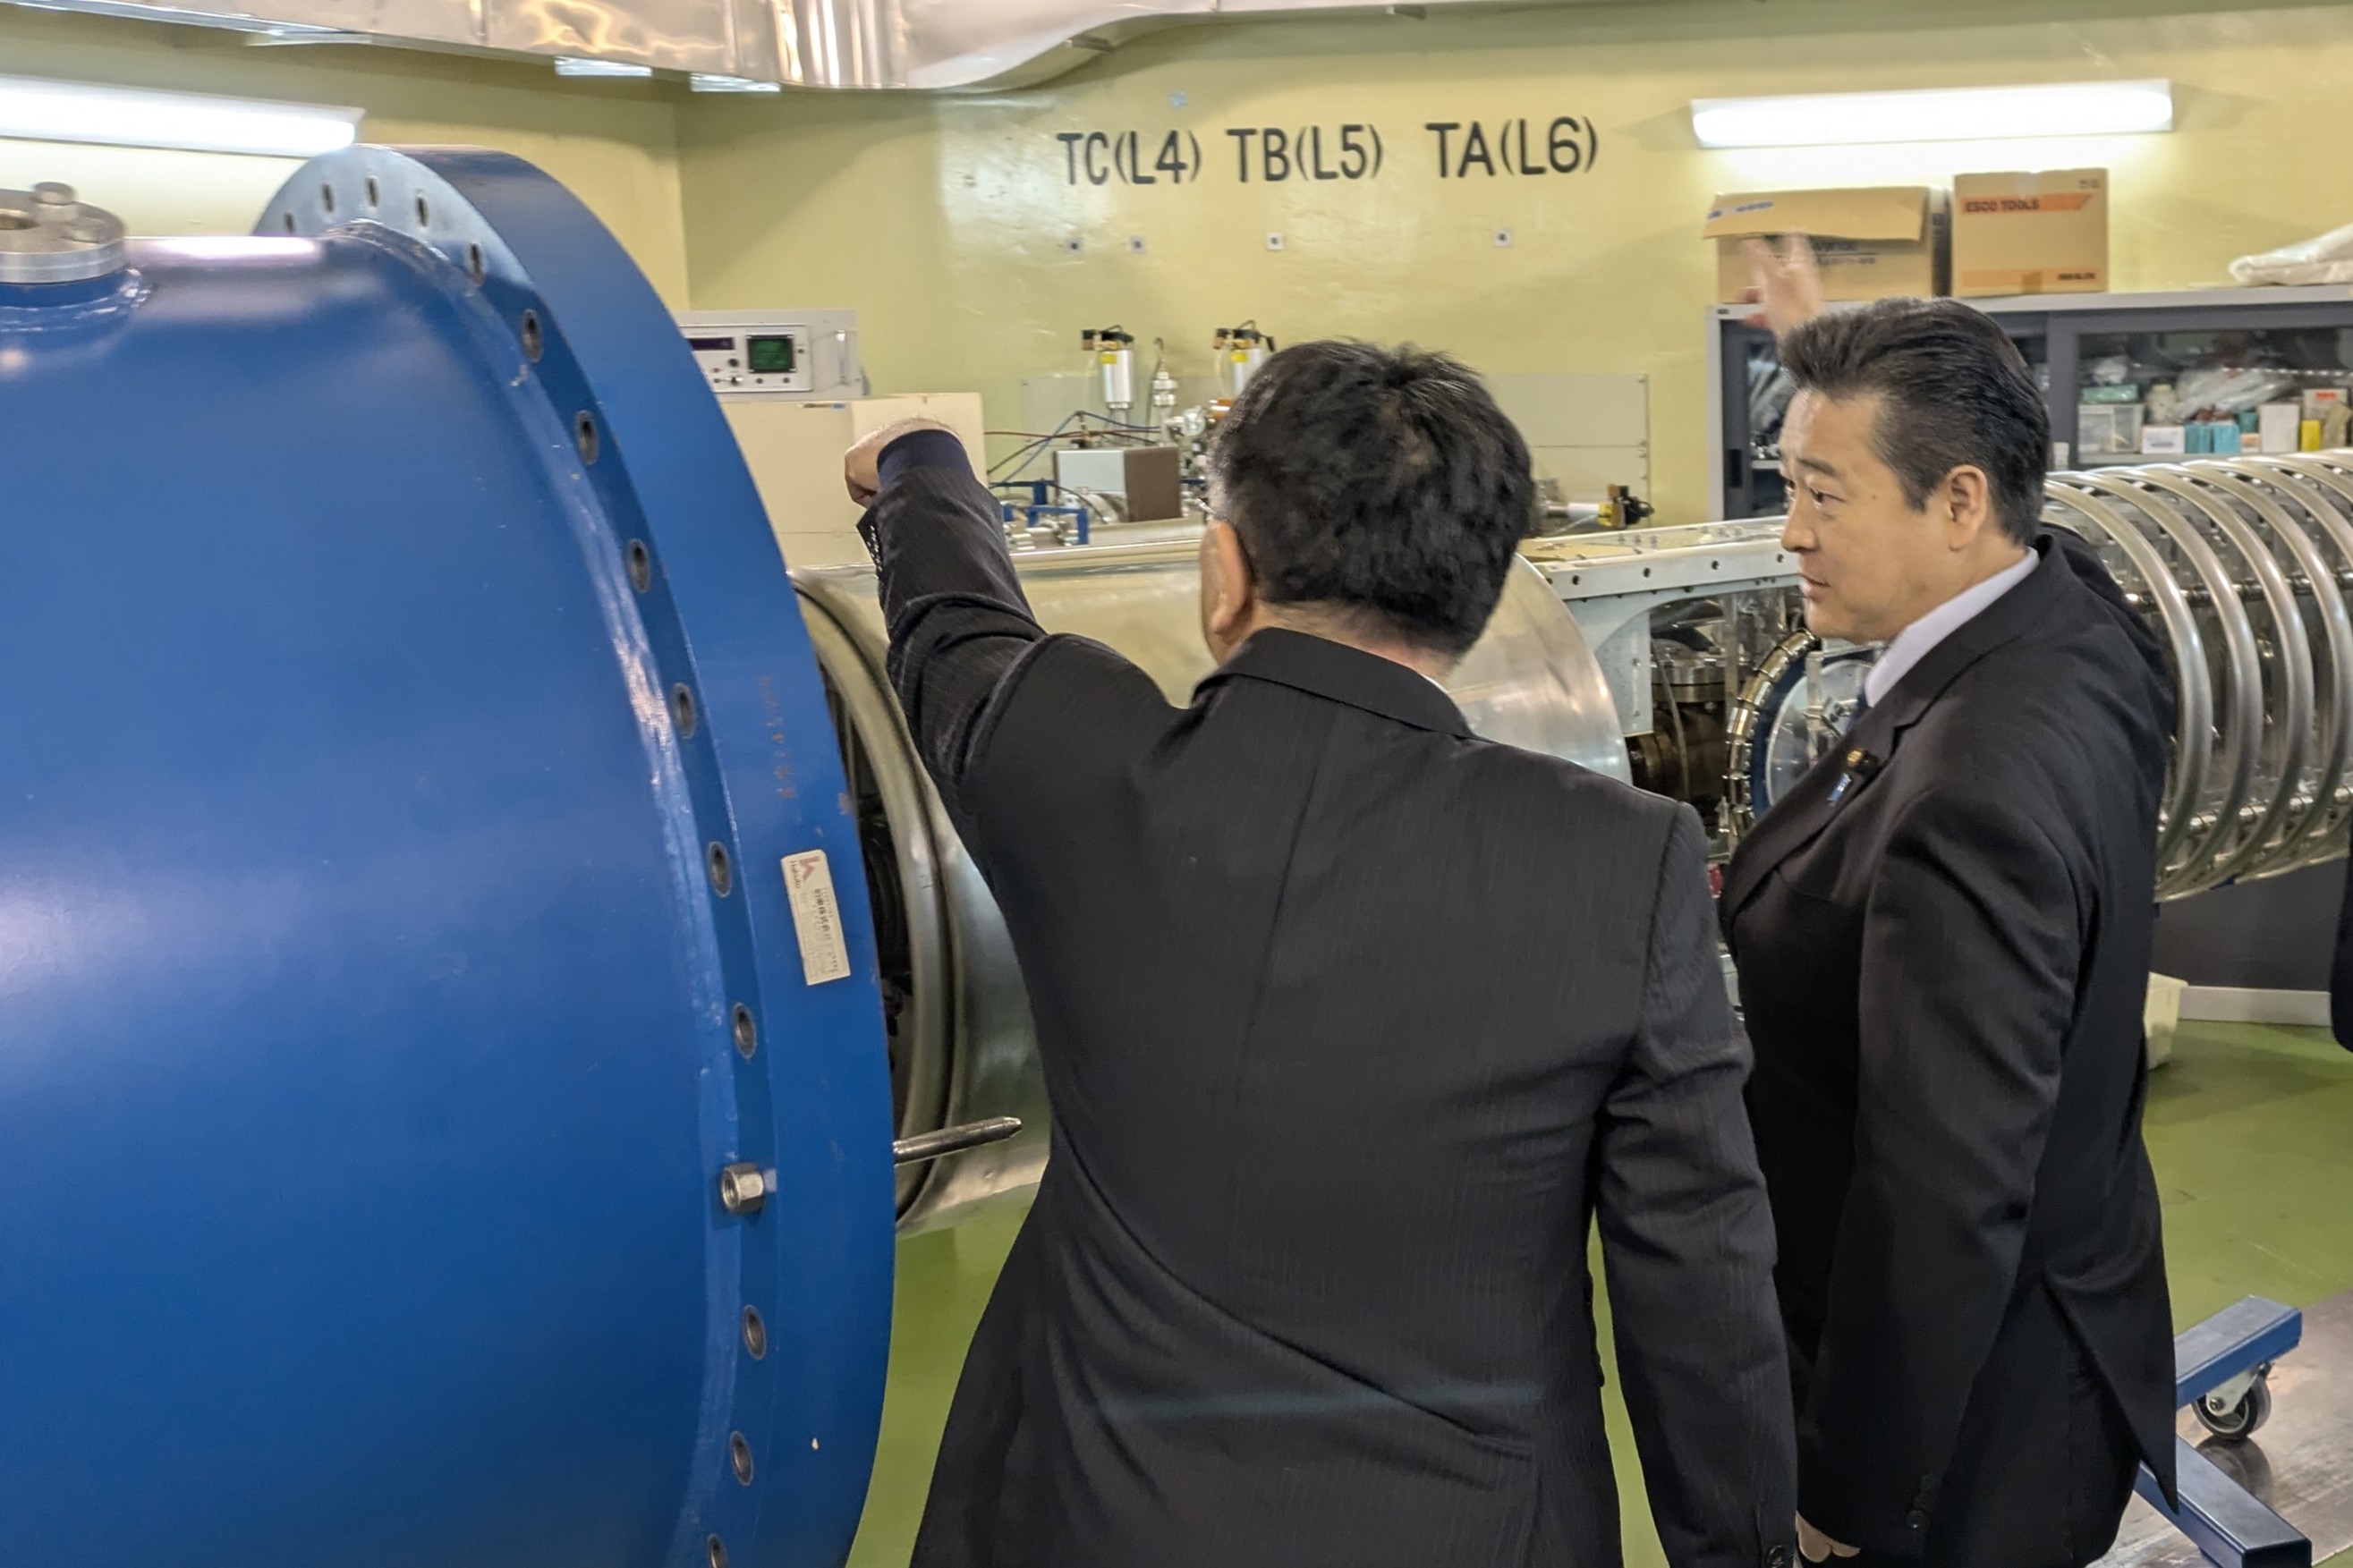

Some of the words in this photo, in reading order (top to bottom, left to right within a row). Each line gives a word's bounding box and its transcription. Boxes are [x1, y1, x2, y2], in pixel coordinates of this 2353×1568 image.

[1057, 130, 1202, 186] TC(L4)
[1226, 123, 1383, 183] TB(L5)
[1424, 116, 1598, 179] TA(L6)
[2000, 199, 2039, 210] TOOLS
